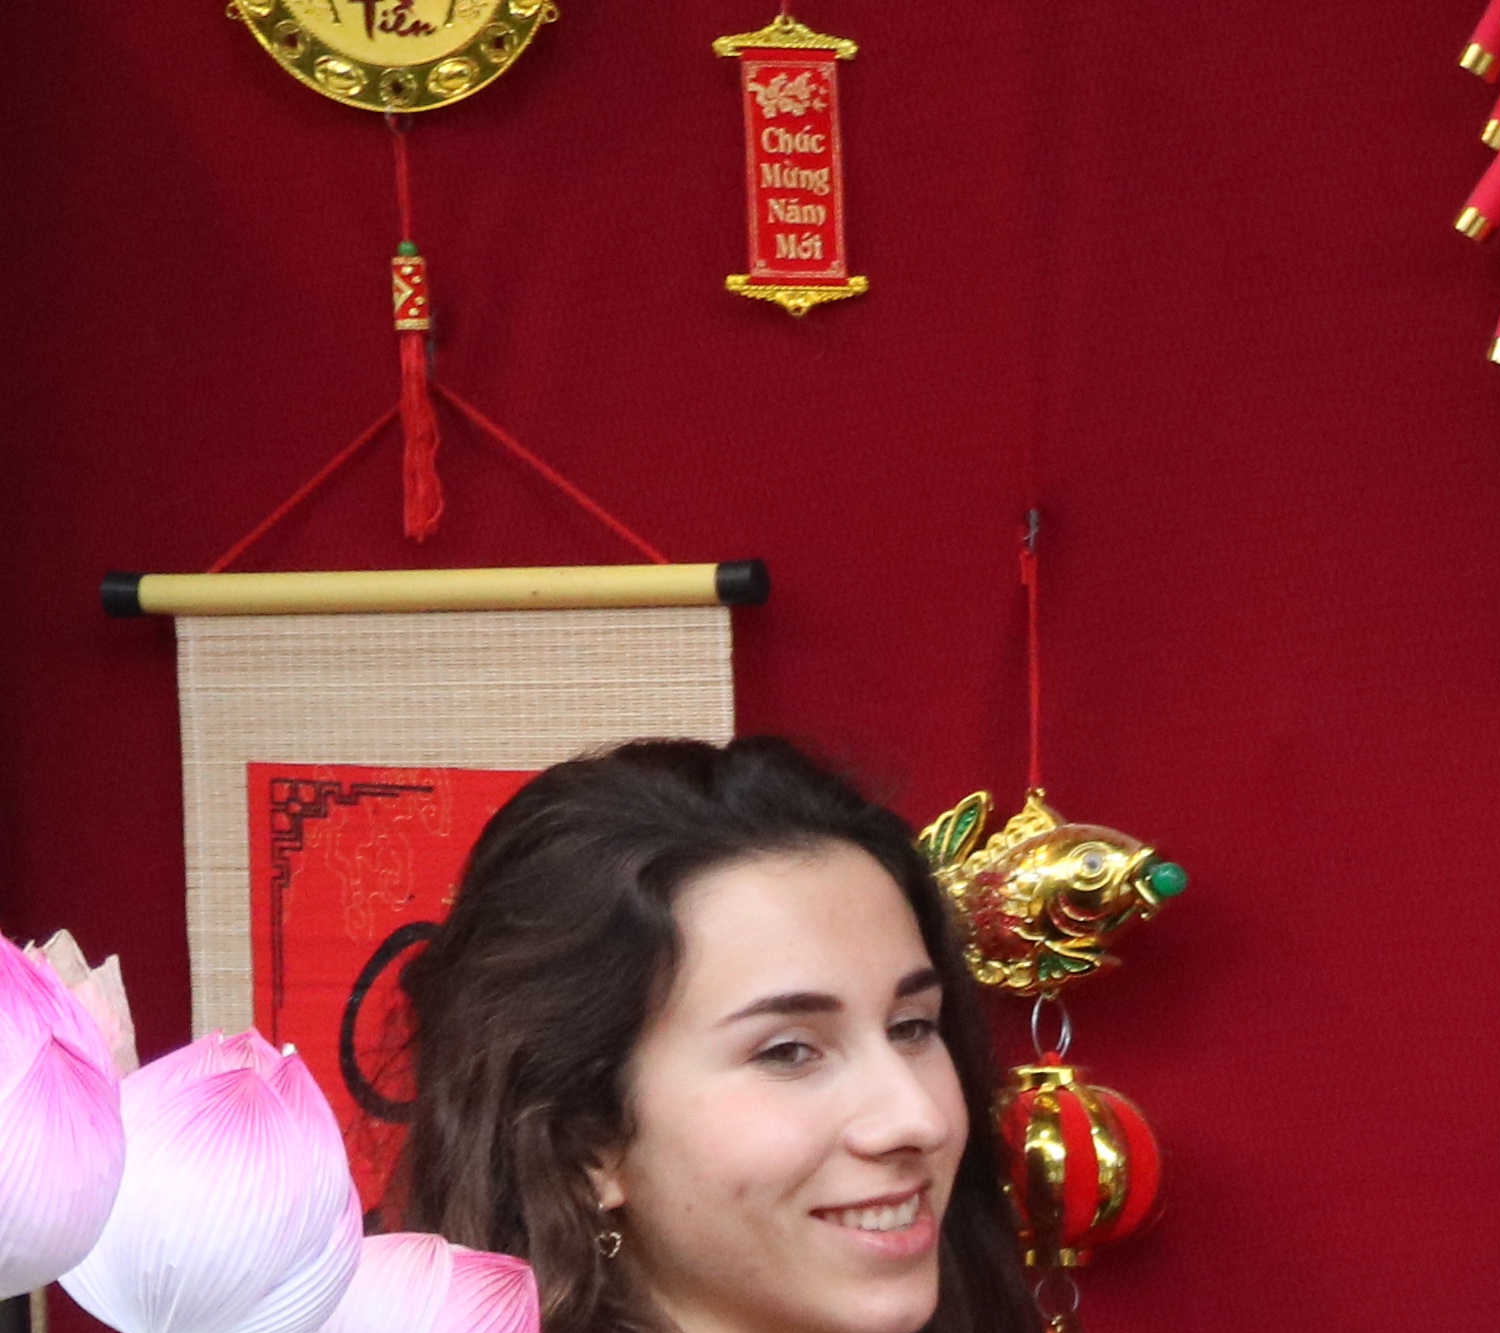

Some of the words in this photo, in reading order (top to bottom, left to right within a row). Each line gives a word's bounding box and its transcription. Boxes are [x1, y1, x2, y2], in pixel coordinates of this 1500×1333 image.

[760, 125, 826, 154] Chúc
[759, 160, 831, 196] Mừng
[767, 198, 826, 227] Năm
[775, 232, 823, 260] Mới
